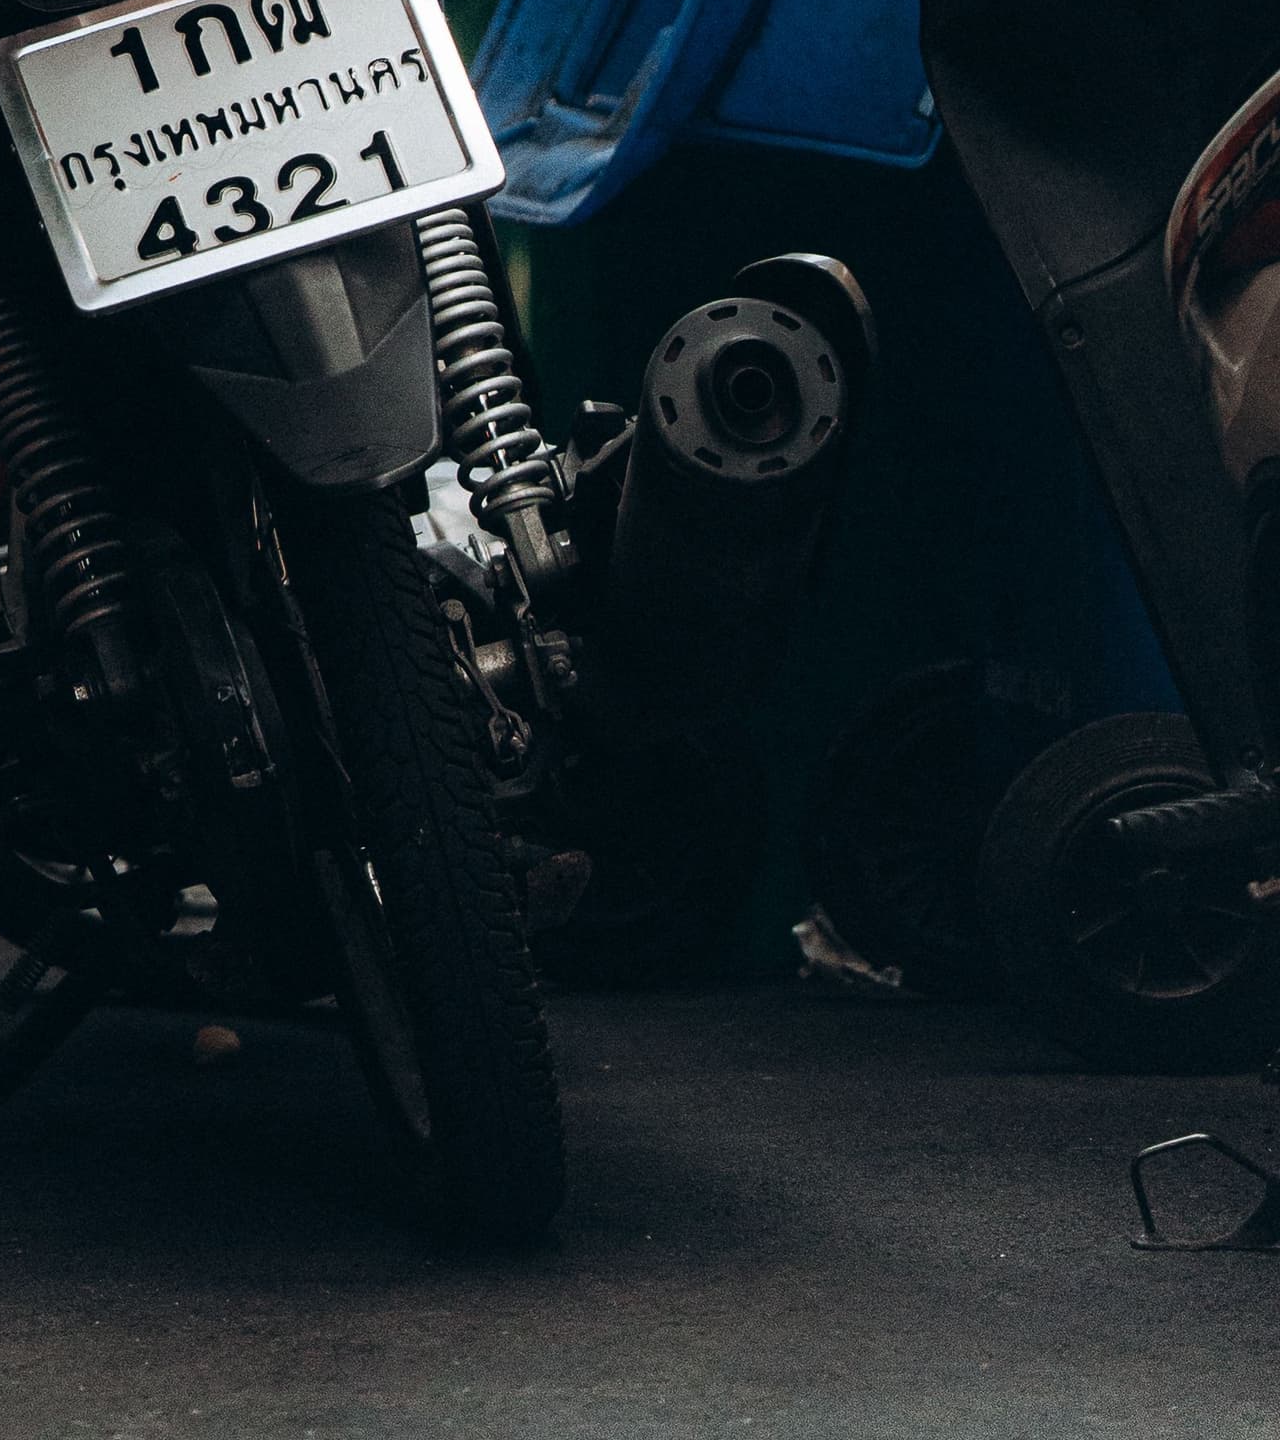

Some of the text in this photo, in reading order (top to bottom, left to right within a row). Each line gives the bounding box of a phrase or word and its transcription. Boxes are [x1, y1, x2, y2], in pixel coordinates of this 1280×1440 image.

[60, 47, 430, 192] กรุงเทพมหานคร
[137, 129, 409, 261] 4321
